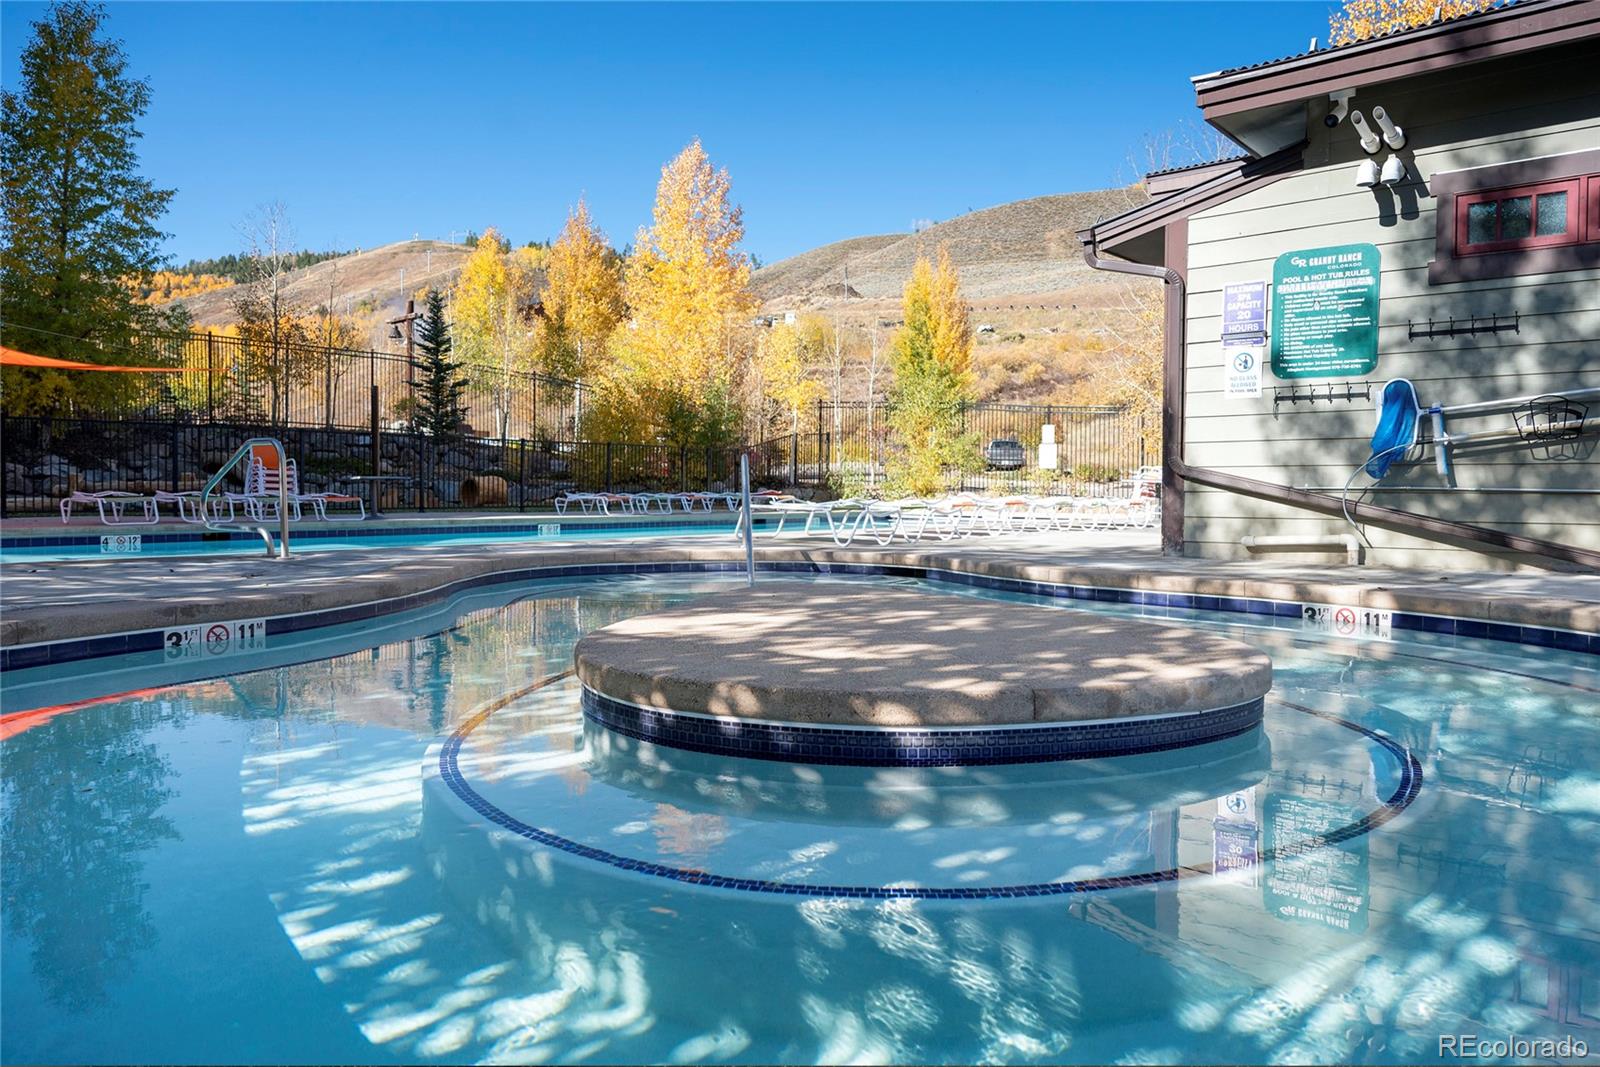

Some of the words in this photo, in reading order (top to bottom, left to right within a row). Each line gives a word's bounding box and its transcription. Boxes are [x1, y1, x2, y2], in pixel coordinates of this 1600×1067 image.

[1309, 256, 1336, 266] GRANBY
[1338, 252, 1362, 262] RANCH
[1345, 269, 1370, 277] RULES
[1228, 300, 1261, 310] CAPACITY
[1237, 310, 1251, 320] 20
[1229, 323, 1258, 333] HOURS
